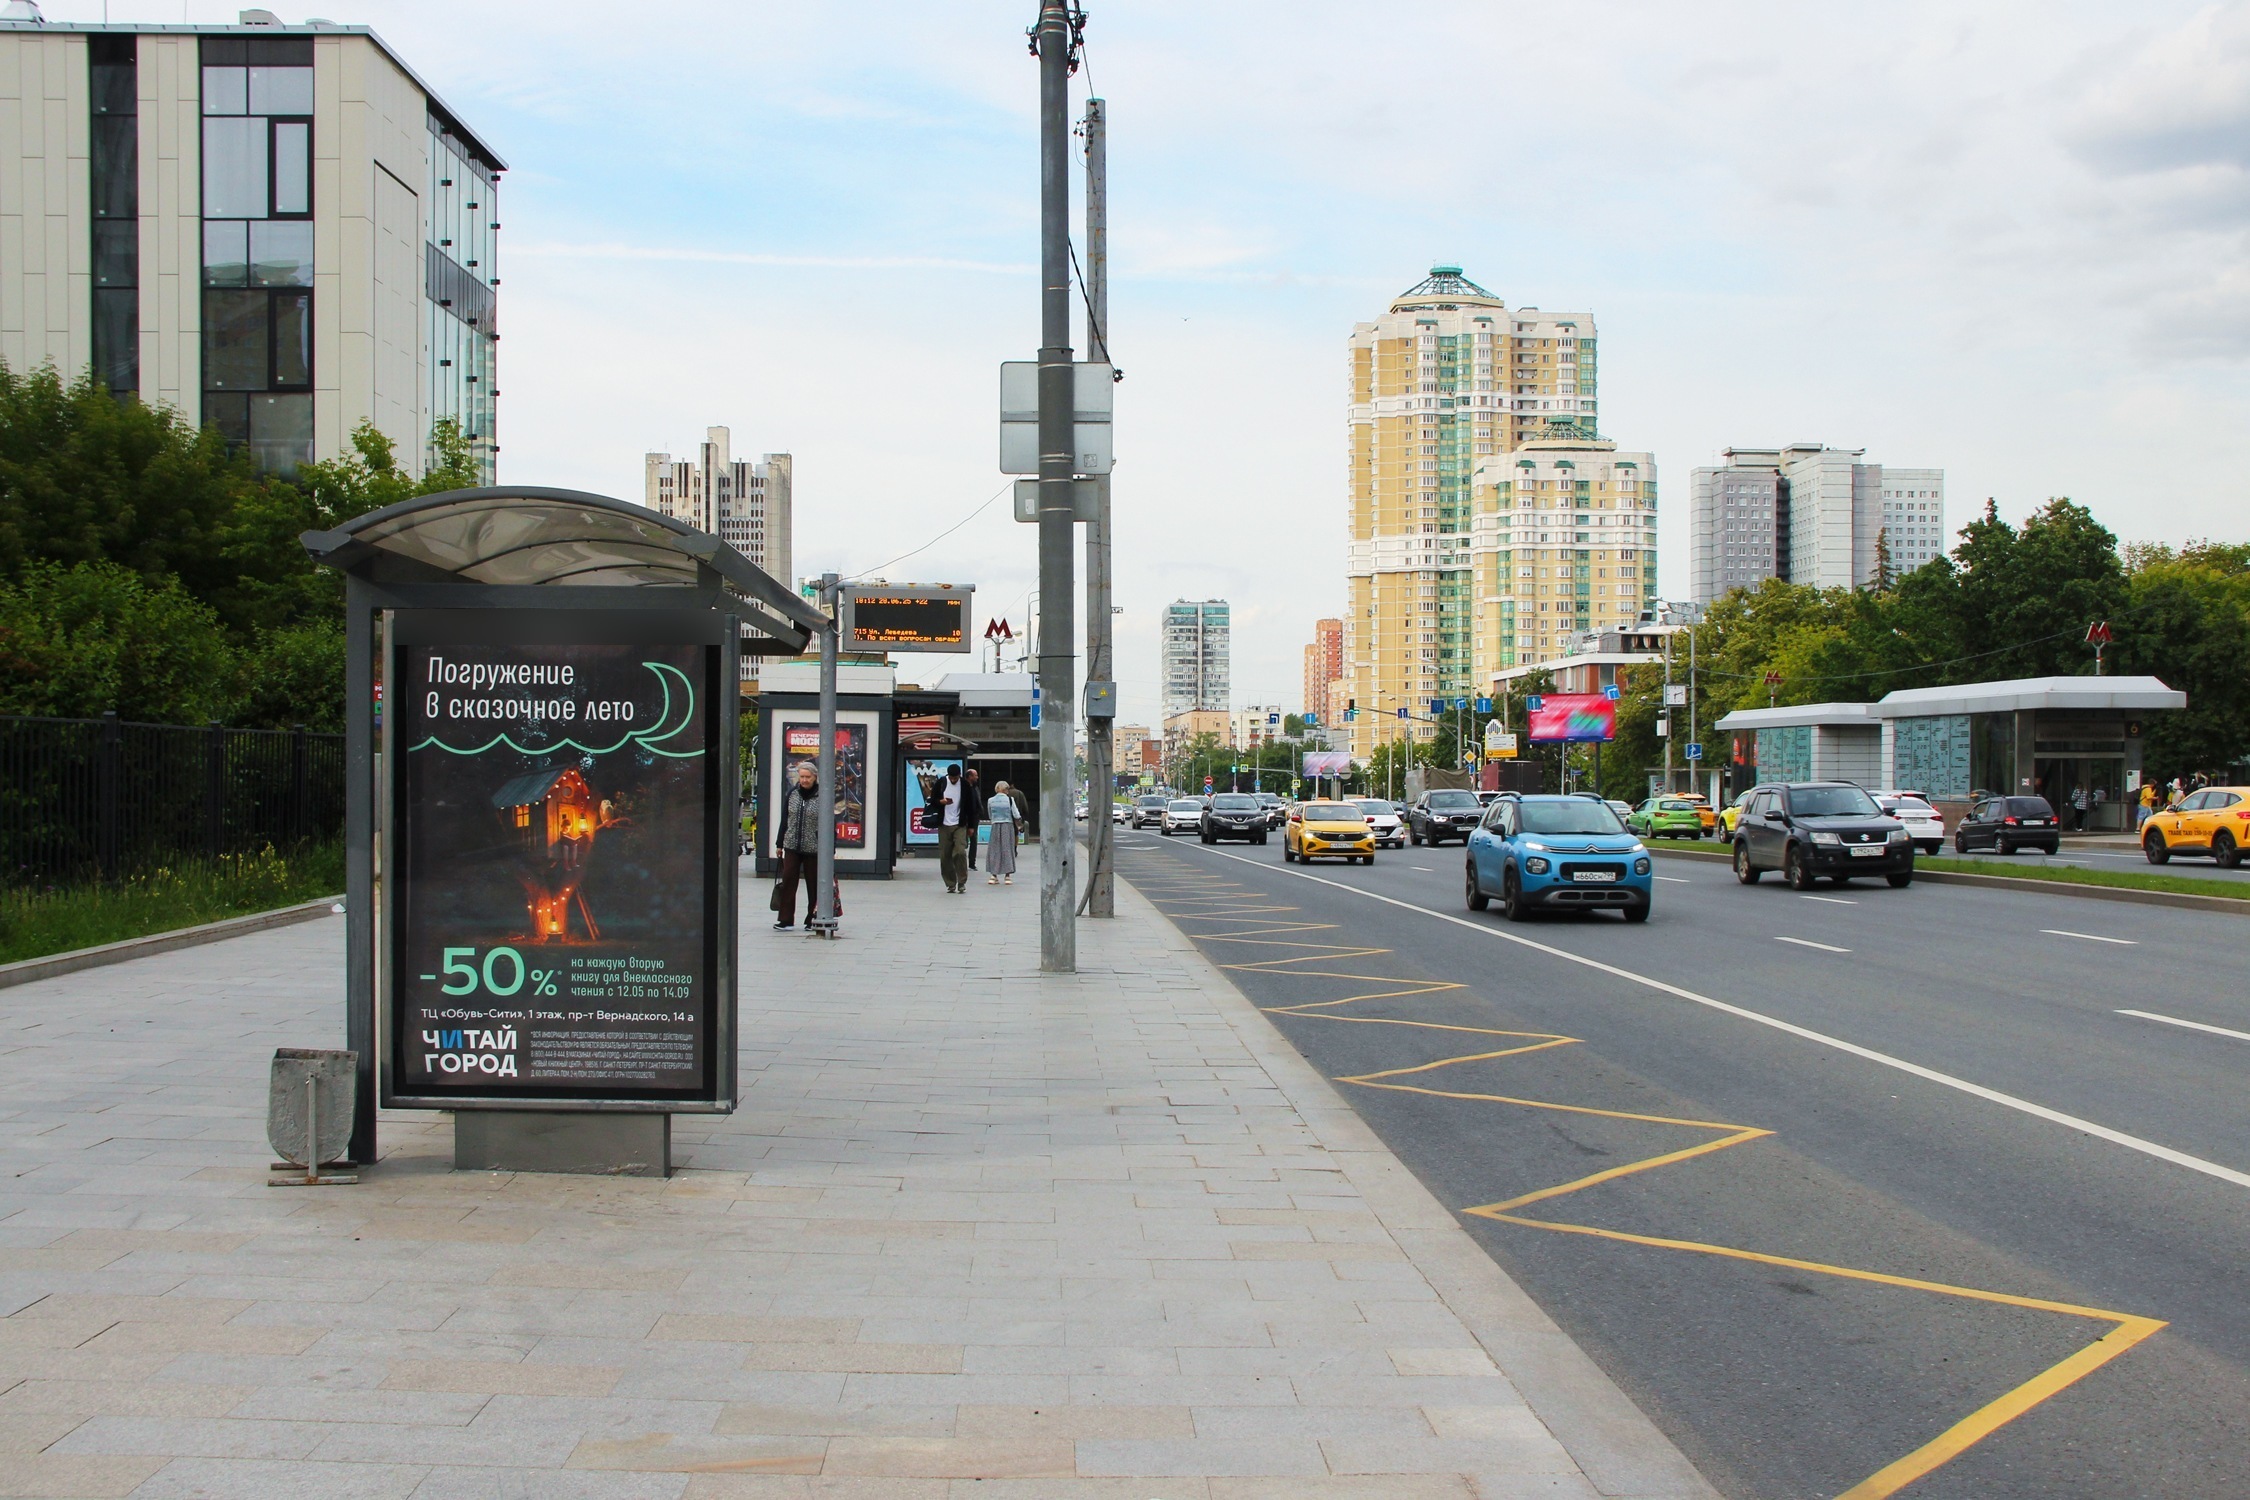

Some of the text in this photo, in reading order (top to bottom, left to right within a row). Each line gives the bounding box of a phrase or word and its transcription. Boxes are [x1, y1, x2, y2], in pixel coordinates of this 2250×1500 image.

[885, 629, 917, 637] Лебедева
[428, 656, 575, 691] Погружение
[425, 691, 635, 721] в сказочное лето
[571, 956, 665, 971] на каждую вторую
[571, 971, 693, 985] книгу для внеклассного
[571, 985, 690, 998] чтения с 12.05 по 14.09
[421, 1008, 694, 1022] ТЦ «Обувь-Сити», 1 этаж, пр-т Вернадского, 14 а
[422, 1024, 517, 1050] ЧИТАЙ
[425, 1053, 518, 1077] ГОРОД
